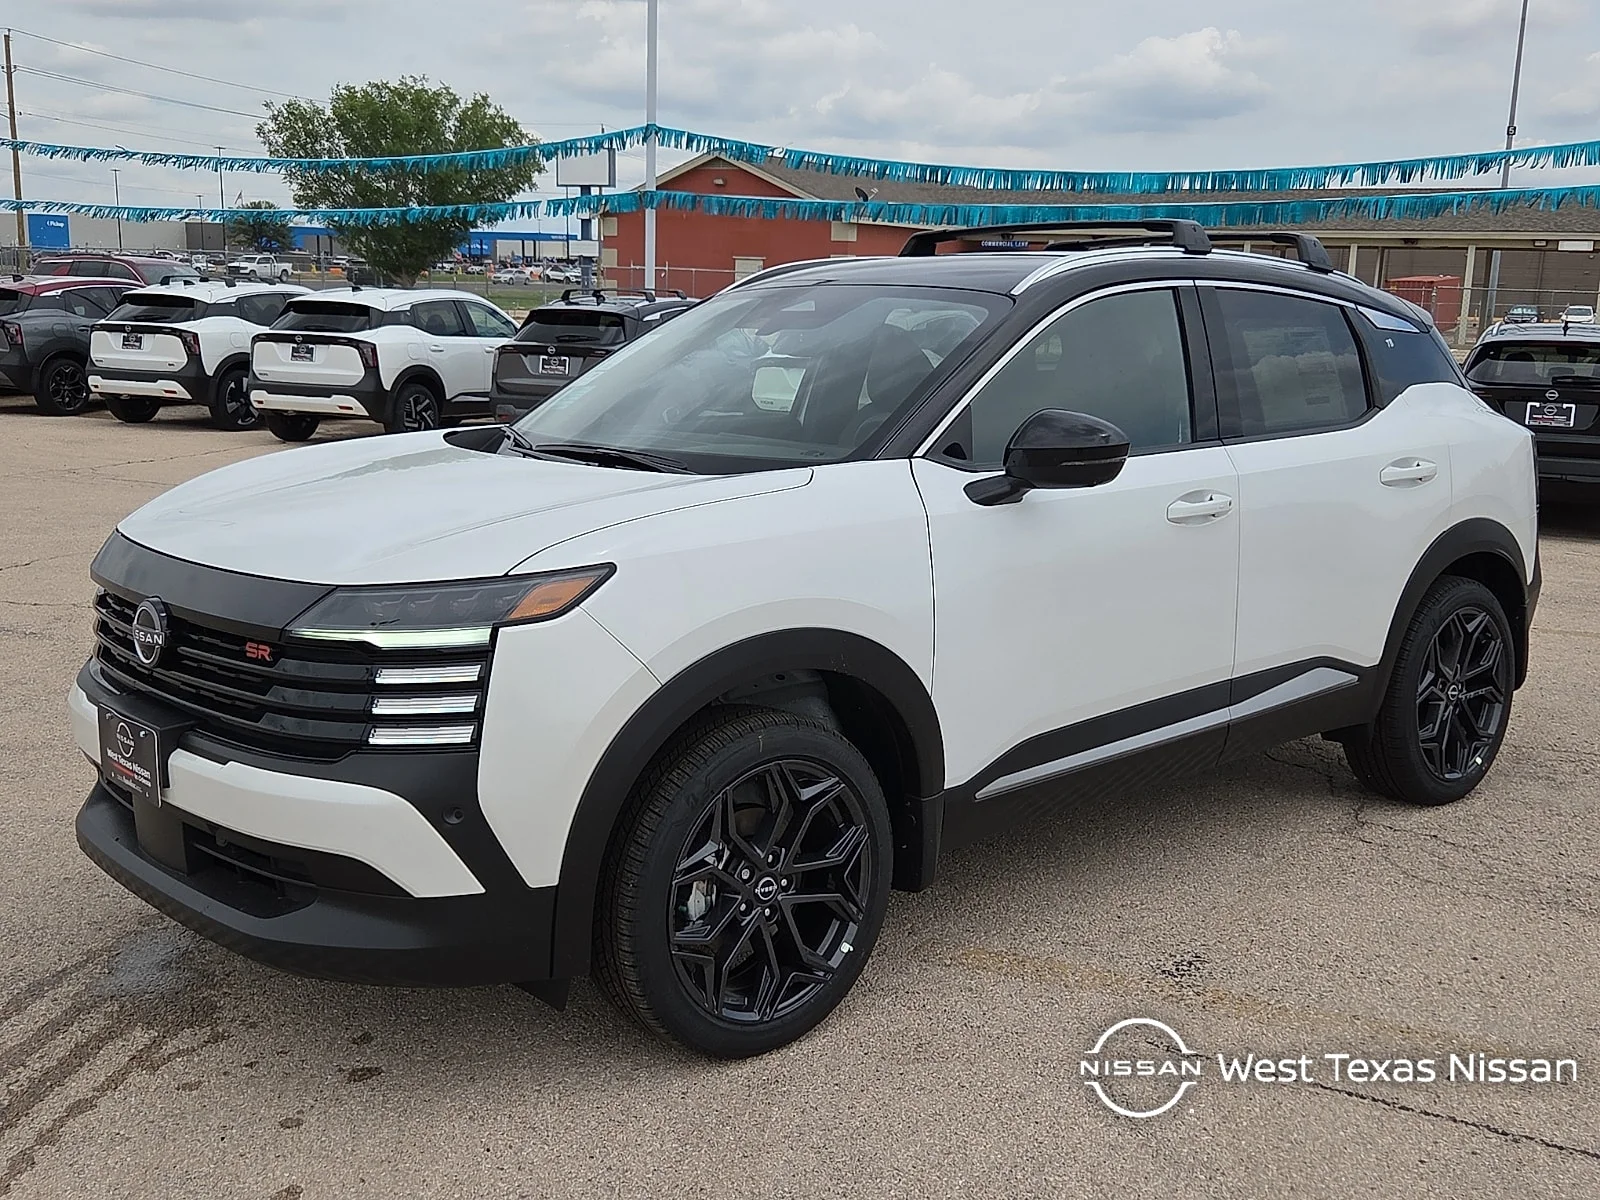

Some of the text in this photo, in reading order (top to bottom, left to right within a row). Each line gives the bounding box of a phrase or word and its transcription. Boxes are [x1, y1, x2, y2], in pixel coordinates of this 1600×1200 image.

[135, 629, 163, 645] SSAN
[245, 642, 273, 662] SR
[106, 746, 151, 780] West Texas Nissan
